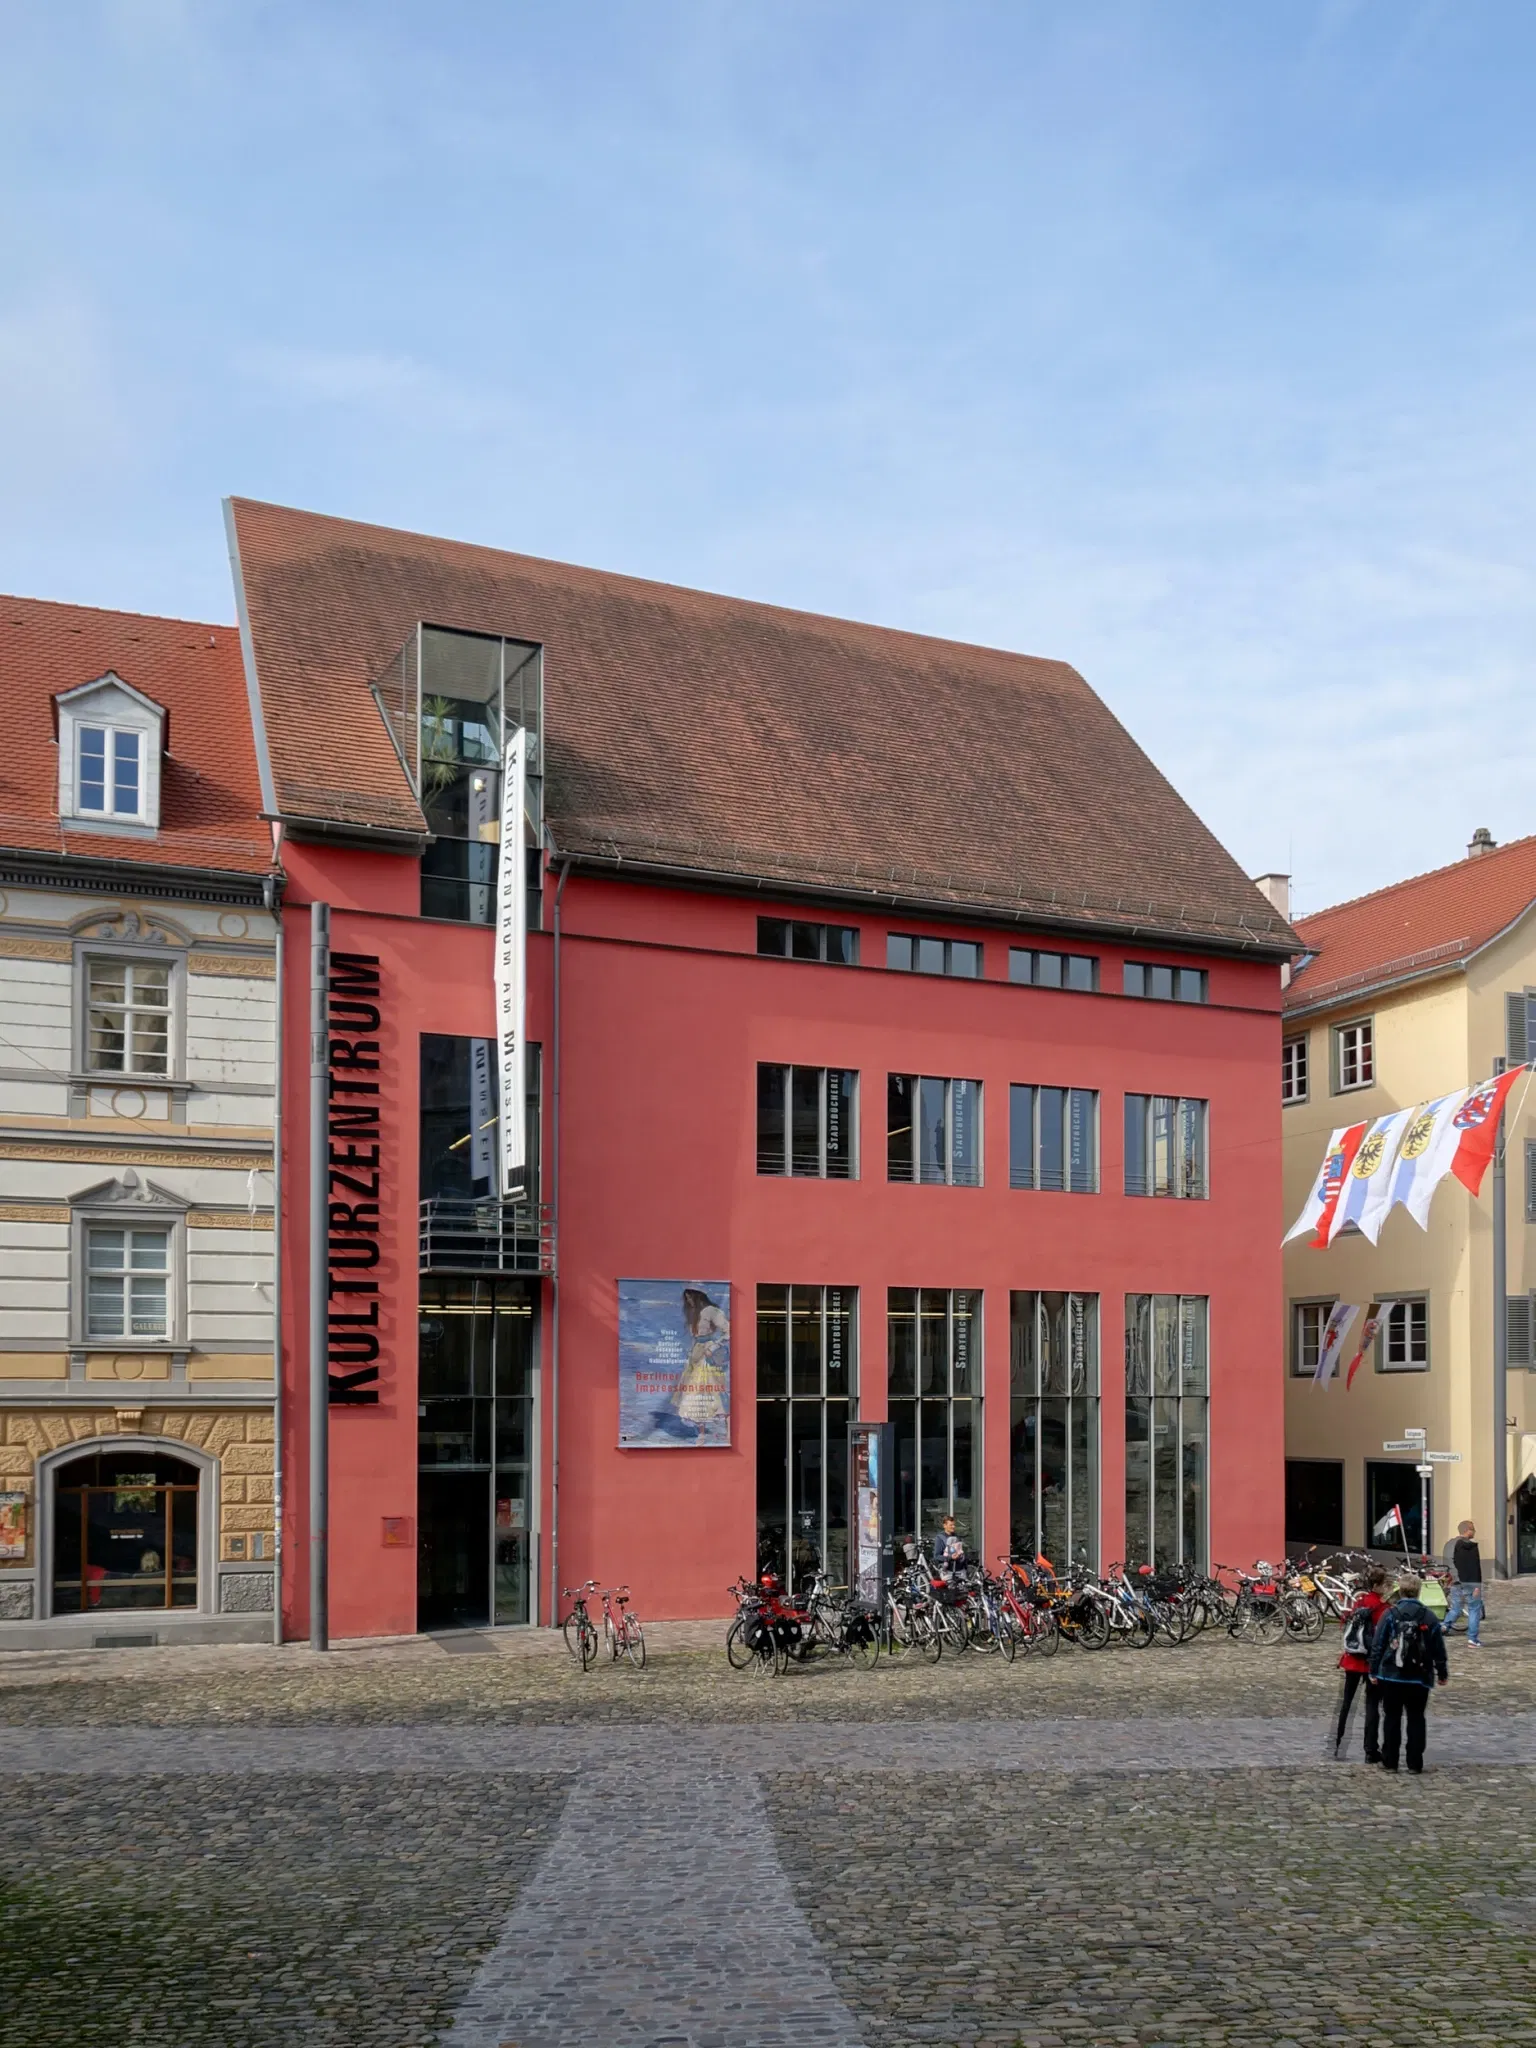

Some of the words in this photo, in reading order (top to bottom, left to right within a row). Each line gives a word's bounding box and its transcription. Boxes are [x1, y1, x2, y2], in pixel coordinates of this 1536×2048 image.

[503, 982, 512, 1014] AM
[328, 951, 381, 1405] KULTURZENTRUM
[829, 1291, 841, 1368] STADTBÜCHEREI
[955, 1295, 967, 1369] STADTBÜCHEREI
[635, 1371, 679, 1381] Berliner
[635, 1383, 726, 1394] Impressionismus
